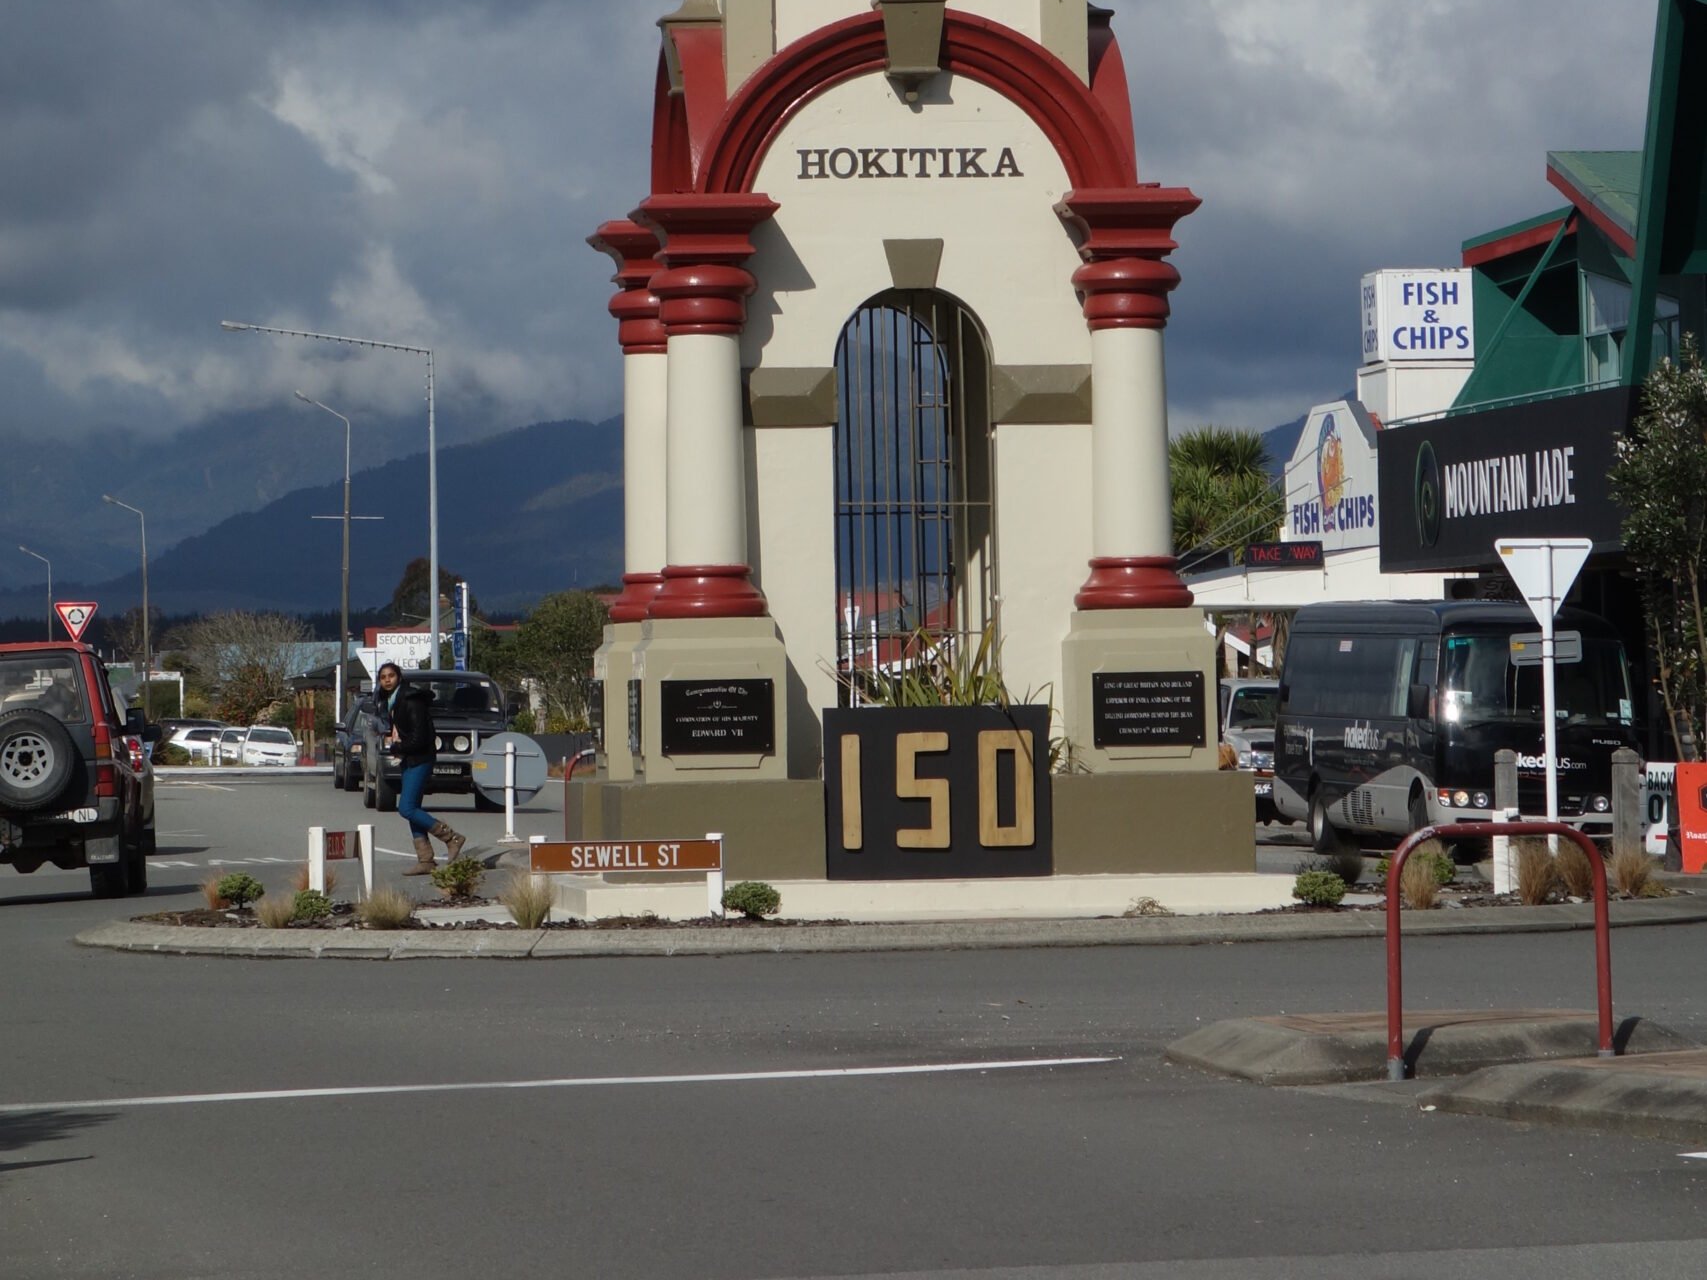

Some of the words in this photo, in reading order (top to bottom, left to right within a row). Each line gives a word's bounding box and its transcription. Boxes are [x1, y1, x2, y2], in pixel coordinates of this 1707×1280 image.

[796, 147, 1025, 180] HOKITIKA
[1363, 285, 1376, 310] FISH
[1403, 281, 1459, 306] FISH
[1423, 309, 1441, 324] &
[1363, 327, 1378, 354] CHIPS
[1392, 325, 1470, 350] CHIPS
[1444, 453, 1529, 519] MOUNTAIN
[1531, 446, 1576, 509] JADE
[1293, 501, 1320, 535] FISH
[1337, 493, 1375, 532] CHIPS
[1251, 546, 1281, 562] TAKE
[378, 635, 432, 646] SECONDHA
[691, 729, 727, 738] EDWARD
[840, 729, 1035, 850] 150
[79, 810, 94, 821] NL
[570, 845, 649, 868] SEWELL
[657, 844, 681, 867] ST
